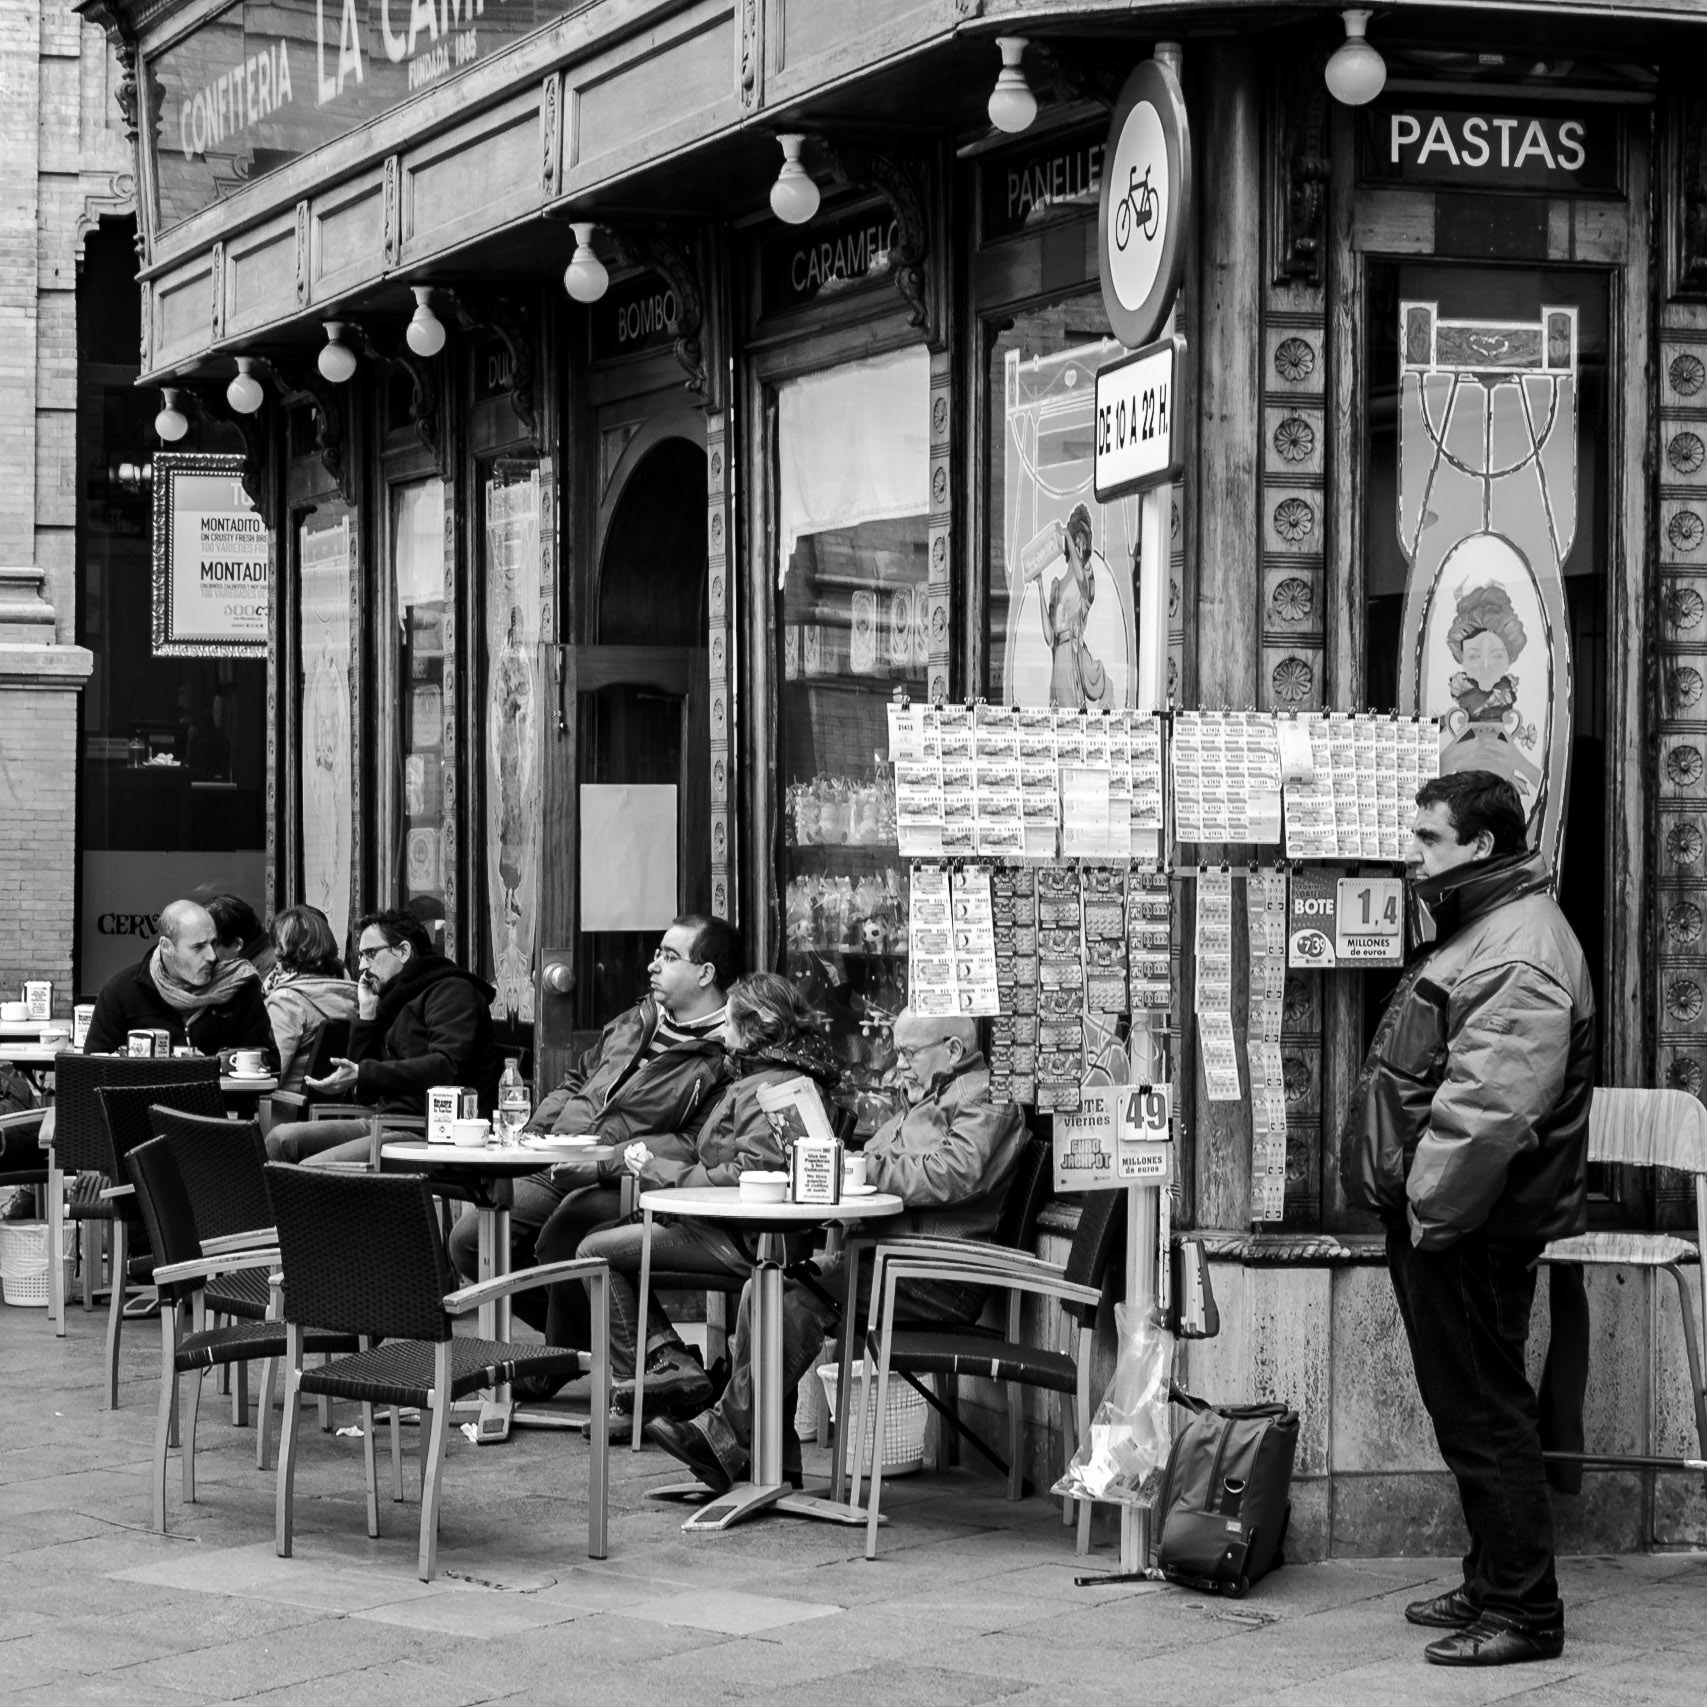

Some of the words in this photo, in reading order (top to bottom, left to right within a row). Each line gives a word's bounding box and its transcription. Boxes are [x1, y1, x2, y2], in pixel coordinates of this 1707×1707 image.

[317, 0, 364, 105] LA
[408, 43, 450, 91] FUNDADA
[181, 38, 293, 161] CONFITERIA
[1391, 114, 1586, 170] PASTAS
[1007, 143, 1107, 218] PANELLE
[618, 290, 677, 342] BOMBO
[1099, 404, 1111, 456] DE
[1116, 399, 1126, 450] 10
[1130, 395, 1138, 446] A
[1142, 387, 1155, 440] 22
[201, 517, 260, 532] MONTADITO
[201, 561, 267, 582] MONTADI
[1295, 899, 1335, 915] BOTE
[97, 912, 161, 939] CERV
[1347, 938, 1390, 948] MILLONES
[1350, 947, 1359, 956] de
[1064, 1114, 1110, 1128] viernes
[1125, 1092, 1167, 1130] 49
[1071, 1138, 1102, 1154] EURO
[1060, 1152, 1111, 1170] JACKPOT
[1122, 1156, 1162, 1166] MILLONES
[1125, 1166, 1135, 1174] de
[1138, 1164, 1160, 1173] euros
